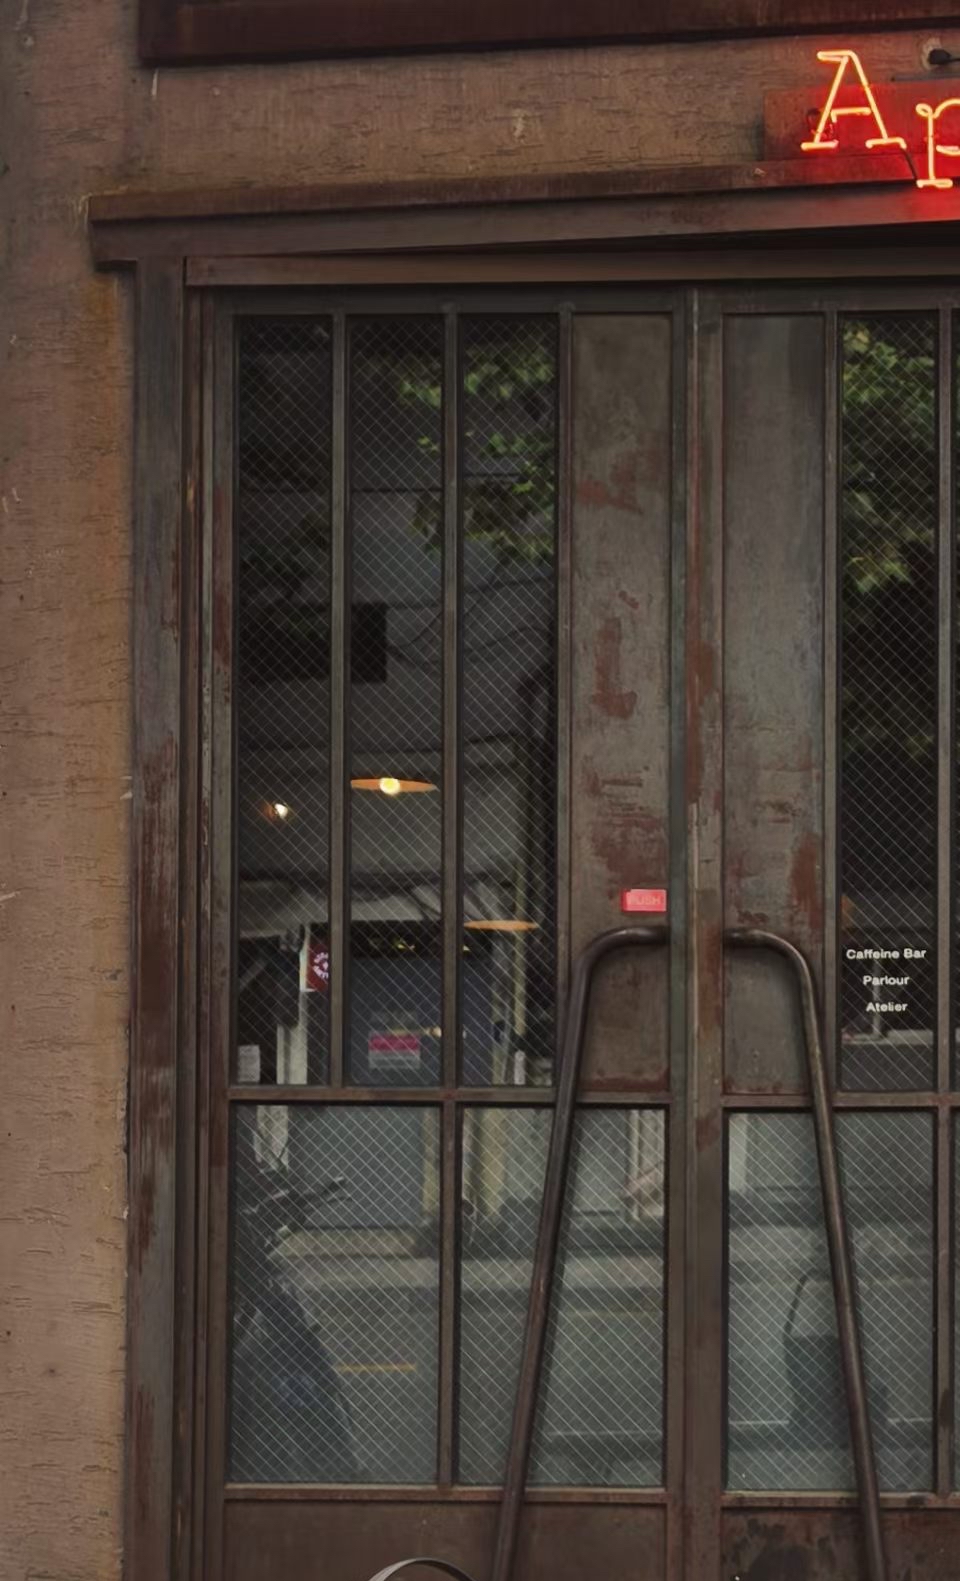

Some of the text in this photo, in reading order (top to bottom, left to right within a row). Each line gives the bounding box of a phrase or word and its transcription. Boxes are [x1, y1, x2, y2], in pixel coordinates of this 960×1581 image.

[846, 947, 927, 960] Caffeine Bar
[862, 975, 910, 986] Parlour
[865, 1001, 908, 1012] Atelier
